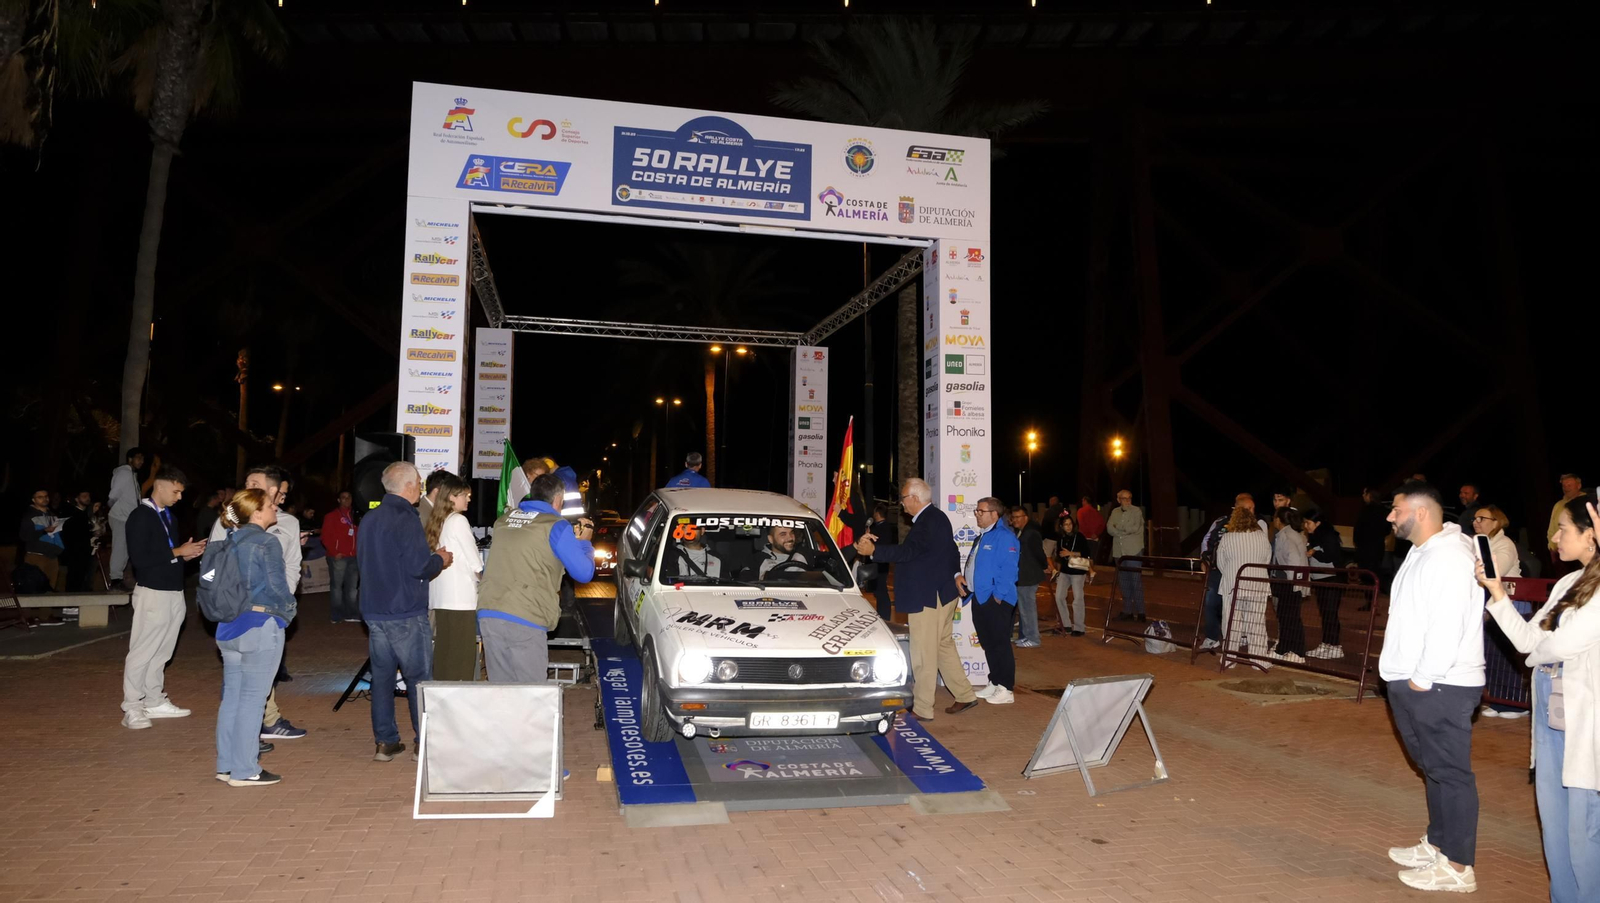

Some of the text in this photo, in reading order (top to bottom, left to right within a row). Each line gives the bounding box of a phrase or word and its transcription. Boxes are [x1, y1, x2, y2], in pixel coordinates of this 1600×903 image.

[500, 160, 557, 176] CERA
[632, 147, 794, 180] 50 RALLYE
[510, 179, 546, 191] Recalvi
[631, 170, 791, 195] COSTA DE ALMERÍA
[846, 198, 888, 209] COSTA DE
[837, 207, 889, 221] ALMERÍA
[919, 206, 975, 219] DIPUTACIÓN
[919, 215, 973, 228] DE ALMERÍA
[414, 253, 459, 265] Rallycar
[420, 275, 450, 284] Recalvi
[411, 328, 456, 340] Rallycar
[416, 350, 447, 359] Recalvi
[945, 381, 985, 393] gasolia
[407, 404, 452, 415] Rallycar
[413, 426, 443, 435] Recalvi
[946, 424, 985, 437] Phonika
[798, 433, 824, 441] gasolia
[798, 460, 823, 468] Phonika
[696, 517, 805, 529] LOS CUÑAOS
[673, 523, 698, 541] 65
[676, 610, 767, 639] MRM
[808, 607, 861, 641] HELADOS
[821, 610, 880, 655] GRANADA
[752, 714, 837, 727] GR 8361 P
[744, 737, 840, 746] DIPUTACIÓN
[775, 742, 842, 751] ALMERÍA
[765, 767, 863, 779] ALMERÍA
